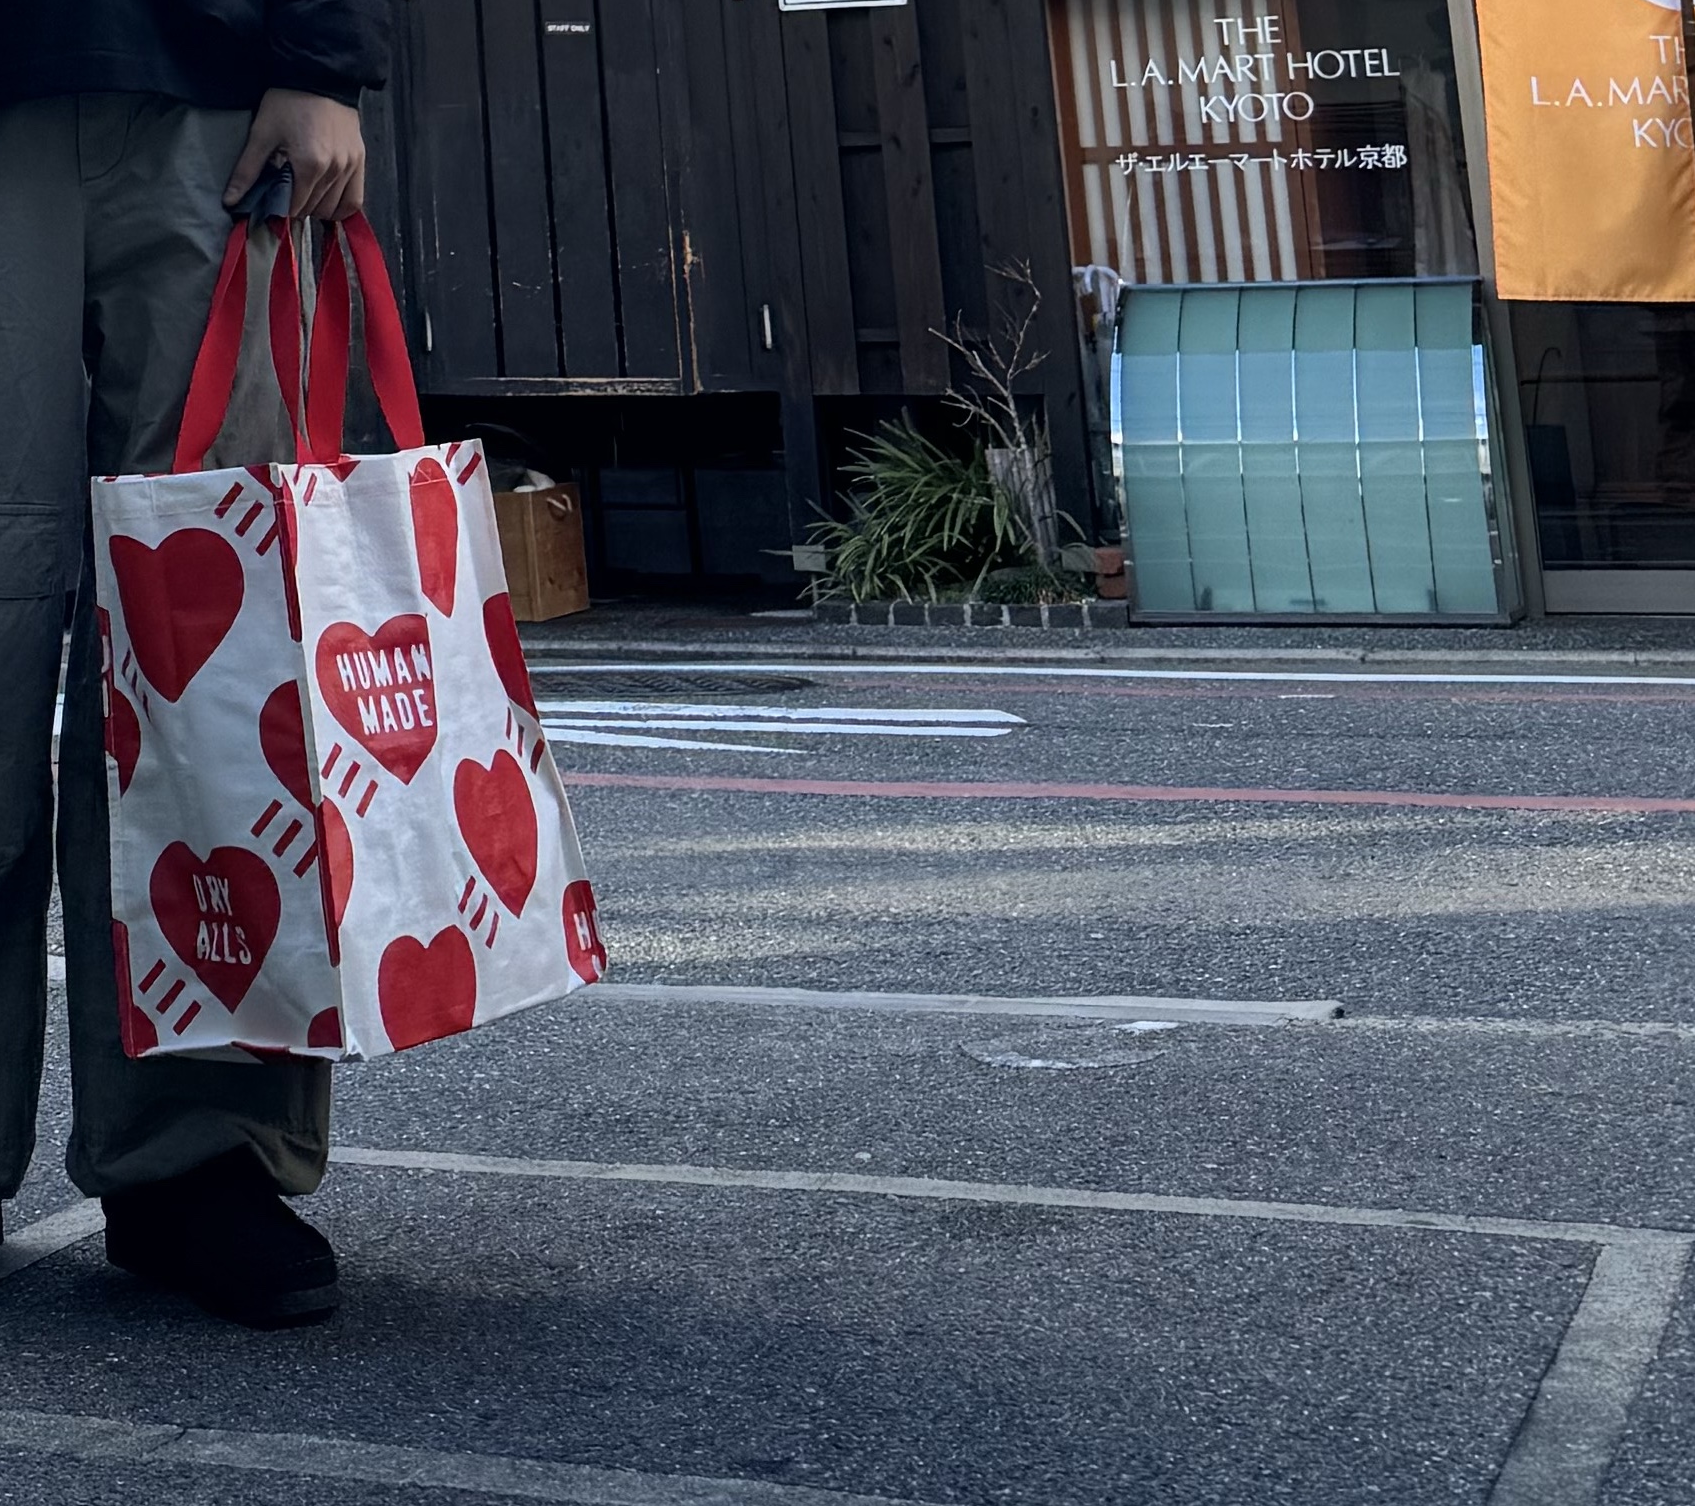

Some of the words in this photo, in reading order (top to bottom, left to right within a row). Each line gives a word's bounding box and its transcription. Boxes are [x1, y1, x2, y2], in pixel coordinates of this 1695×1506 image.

[1213, 15, 1282, 46] THE
[1109, 53, 1275, 88] L.A.MART
[1287, 48, 1401, 80] HOTEL
[1199, 91, 1315, 124] KYOTO
[336, 643, 431, 692] HUMAN
[357, 688, 434, 735] MADE
[192, 874, 233, 916] DRY
[196, 920, 252, 965] ALLS
